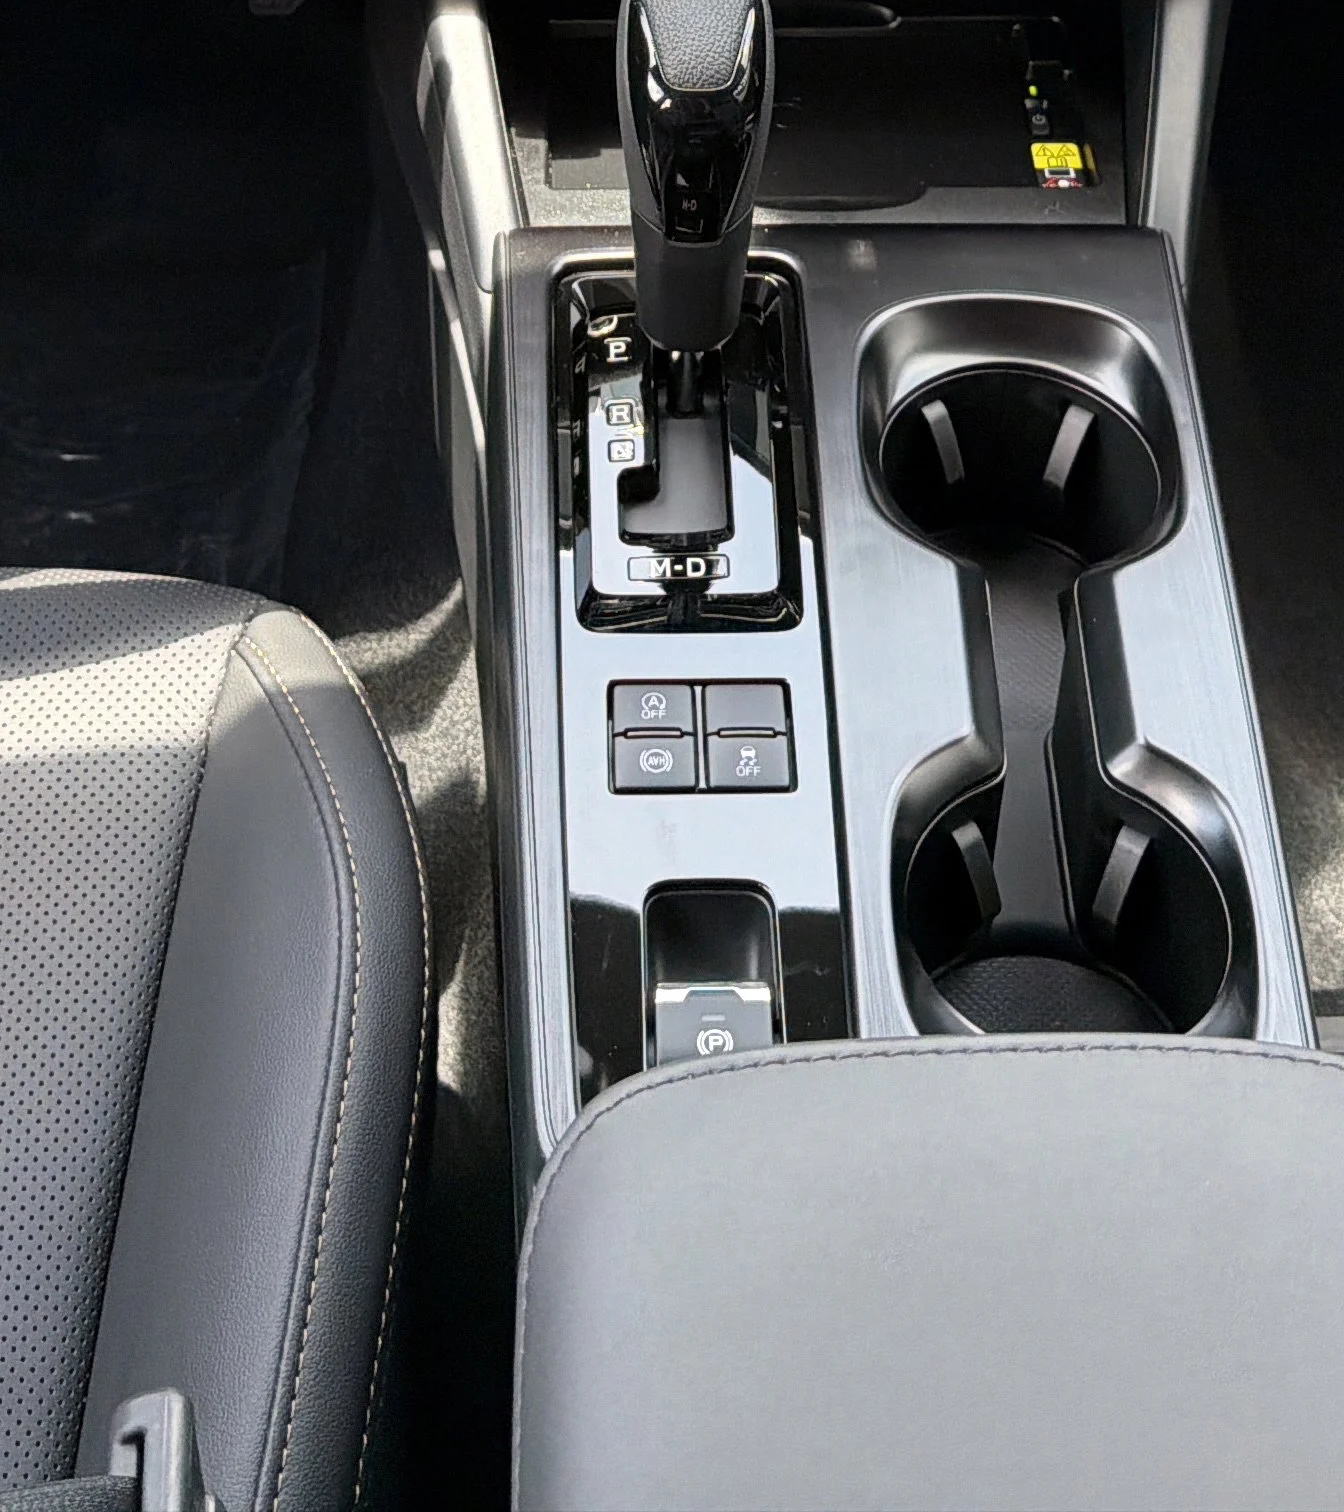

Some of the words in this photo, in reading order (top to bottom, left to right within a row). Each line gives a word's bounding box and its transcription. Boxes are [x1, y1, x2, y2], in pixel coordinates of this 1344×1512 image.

[641, 709, 667, 720] OFF
[647, 755, 666, 766] AVH
[736, 766, 761, 777] OFF
